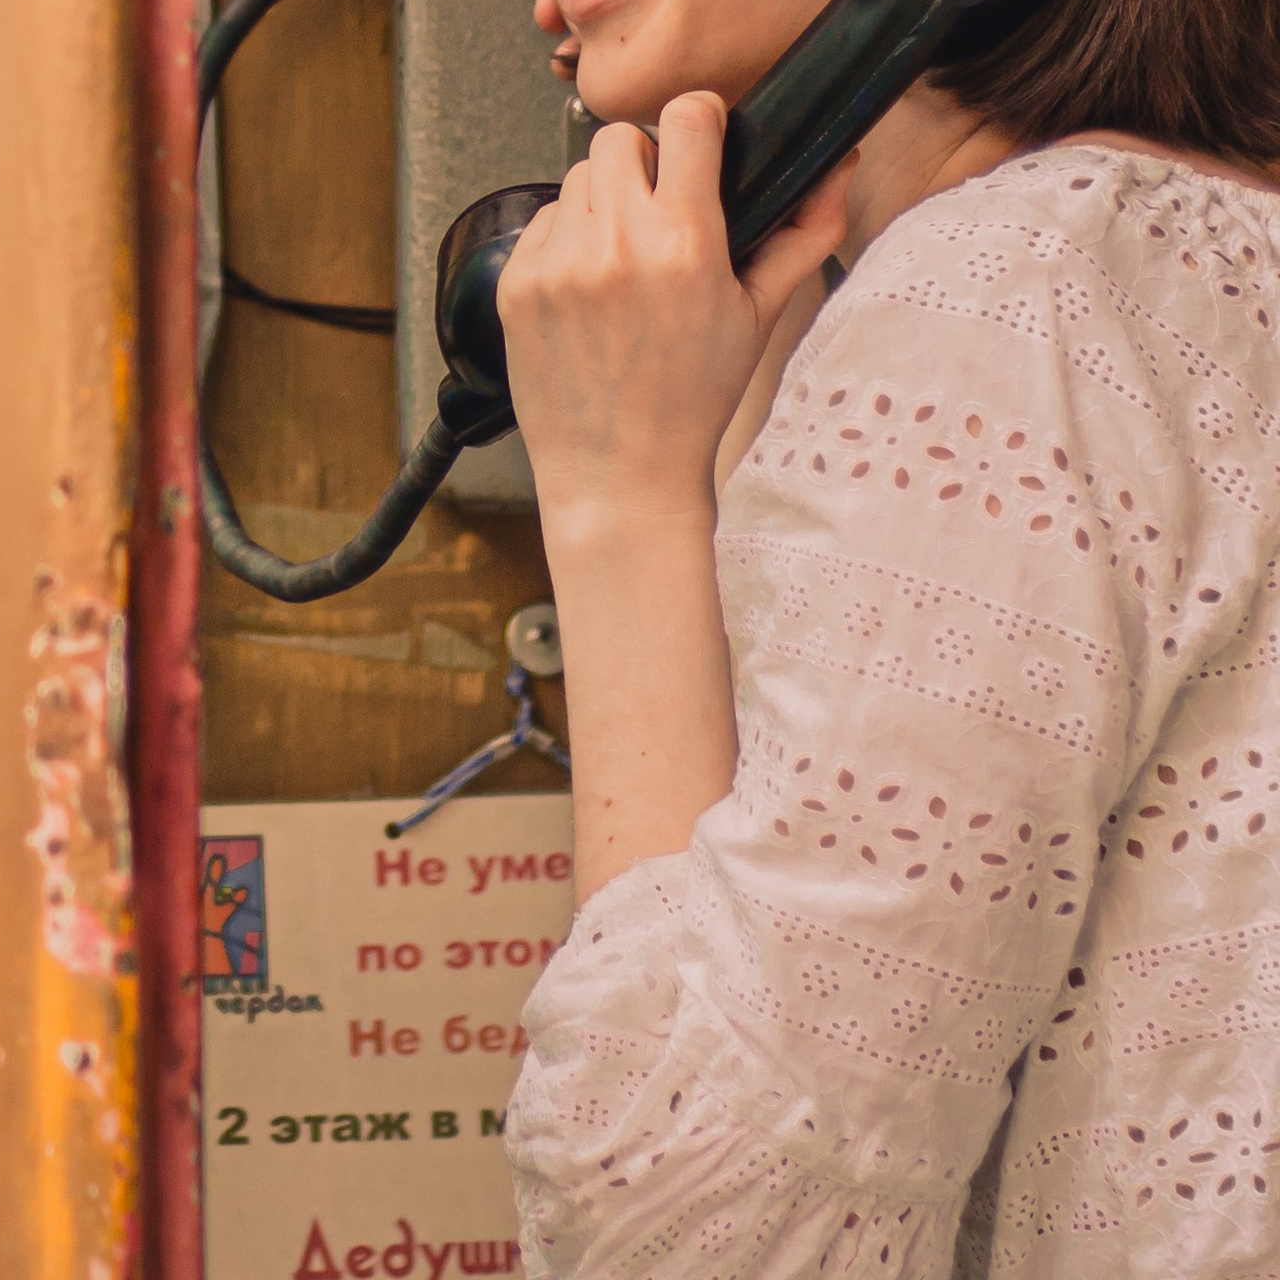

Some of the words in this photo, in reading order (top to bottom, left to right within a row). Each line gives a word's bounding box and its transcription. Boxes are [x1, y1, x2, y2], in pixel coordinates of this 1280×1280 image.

[374, 848, 447, 887] Не
[466, 851, 572, 894] уме
[356, 940, 424, 972] по
[348, 1019, 422, 1057] Не
[217, 1106, 251, 1146] 2
[269, 1110, 412, 1144] этаж
[431, 1109, 460, 1139] в
